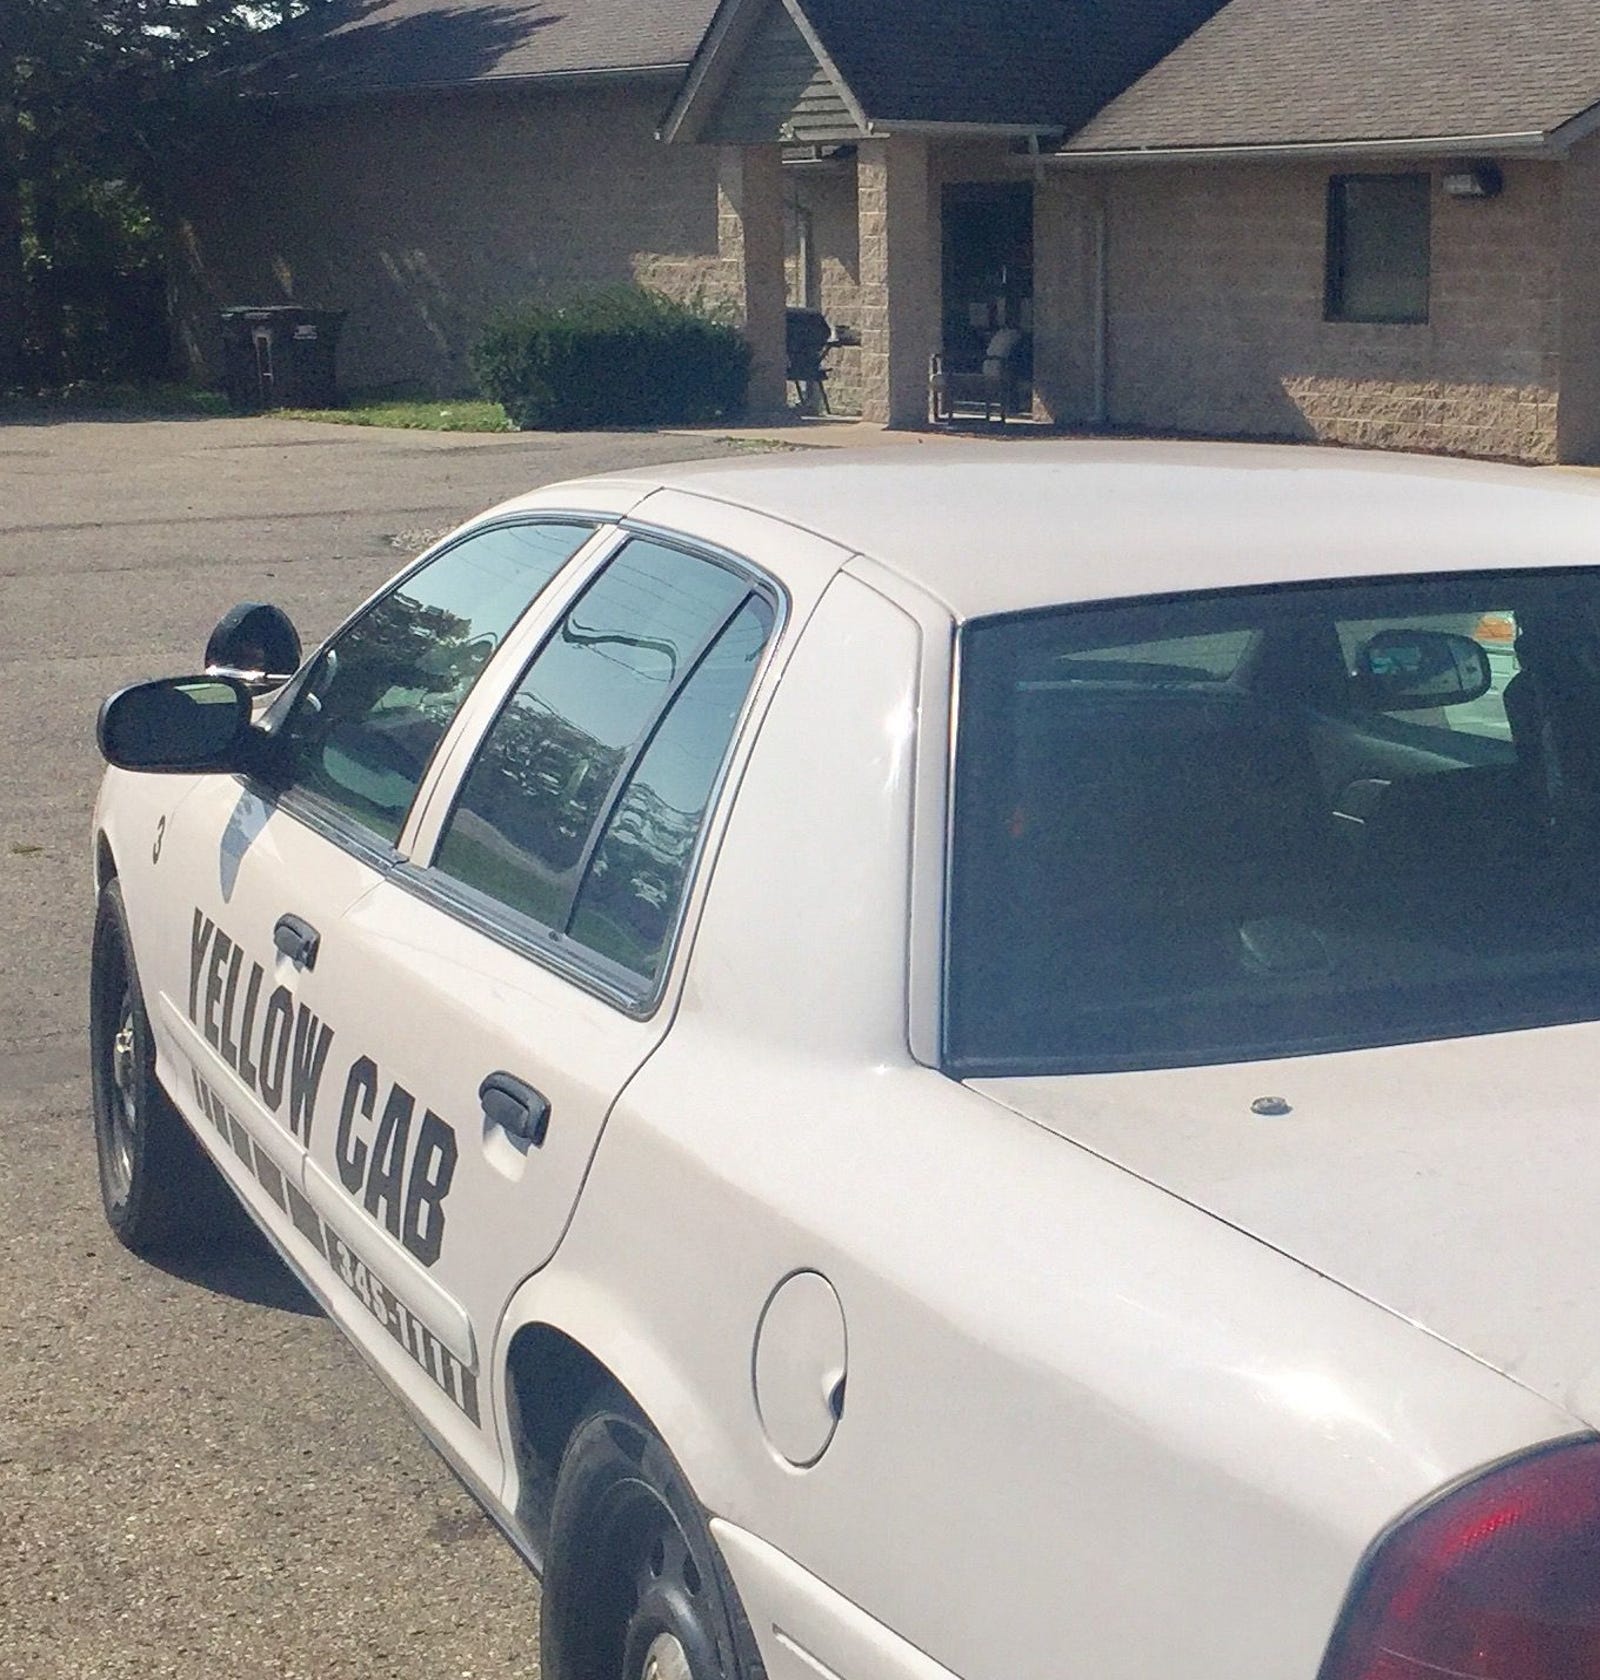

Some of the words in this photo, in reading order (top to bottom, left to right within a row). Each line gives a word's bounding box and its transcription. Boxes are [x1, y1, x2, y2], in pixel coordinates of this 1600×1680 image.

[152, 815, 166, 864] 3
[189, 907, 334, 1152] YELLOW
[335, 1055, 458, 1267] CAB
[335, 1238, 467, 1412] 345-1111
